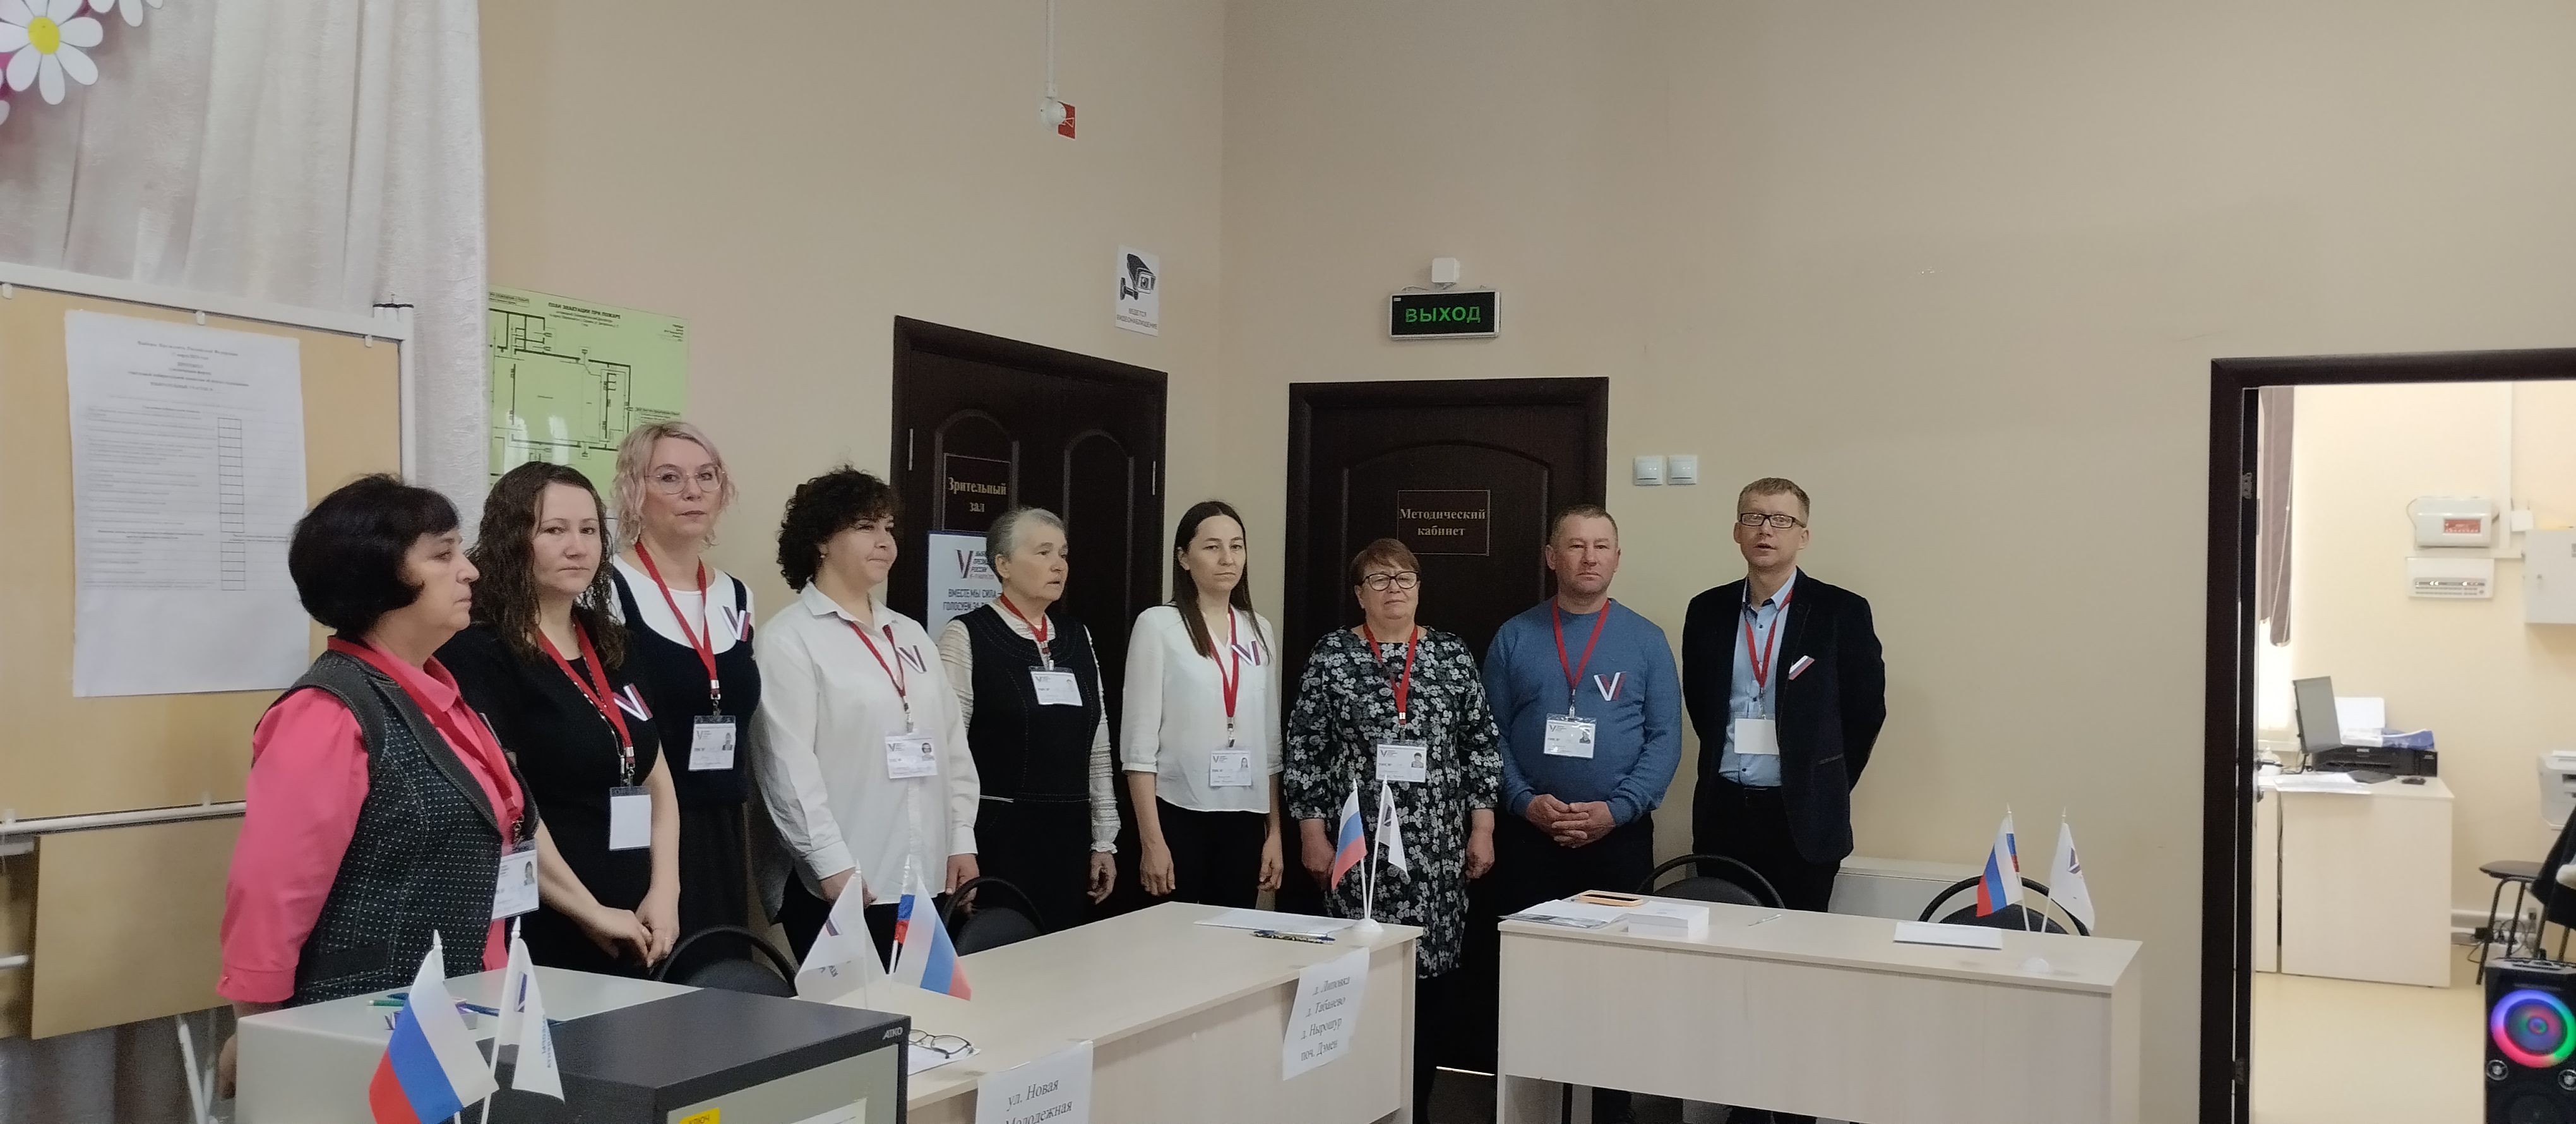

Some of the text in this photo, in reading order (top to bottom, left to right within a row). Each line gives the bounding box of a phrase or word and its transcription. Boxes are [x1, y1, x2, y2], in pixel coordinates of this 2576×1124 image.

[1405, 306, 1481, 323] ВЫХОД
[948, 477, 1006, 495] Зрительный
[969, 502, 985, 513] зал
[1398, 508, 1486, 520] Методический
[1417, 525, 1466, 536] кабинет
[1006, 1079, 1059, 1112] ул. Новая
